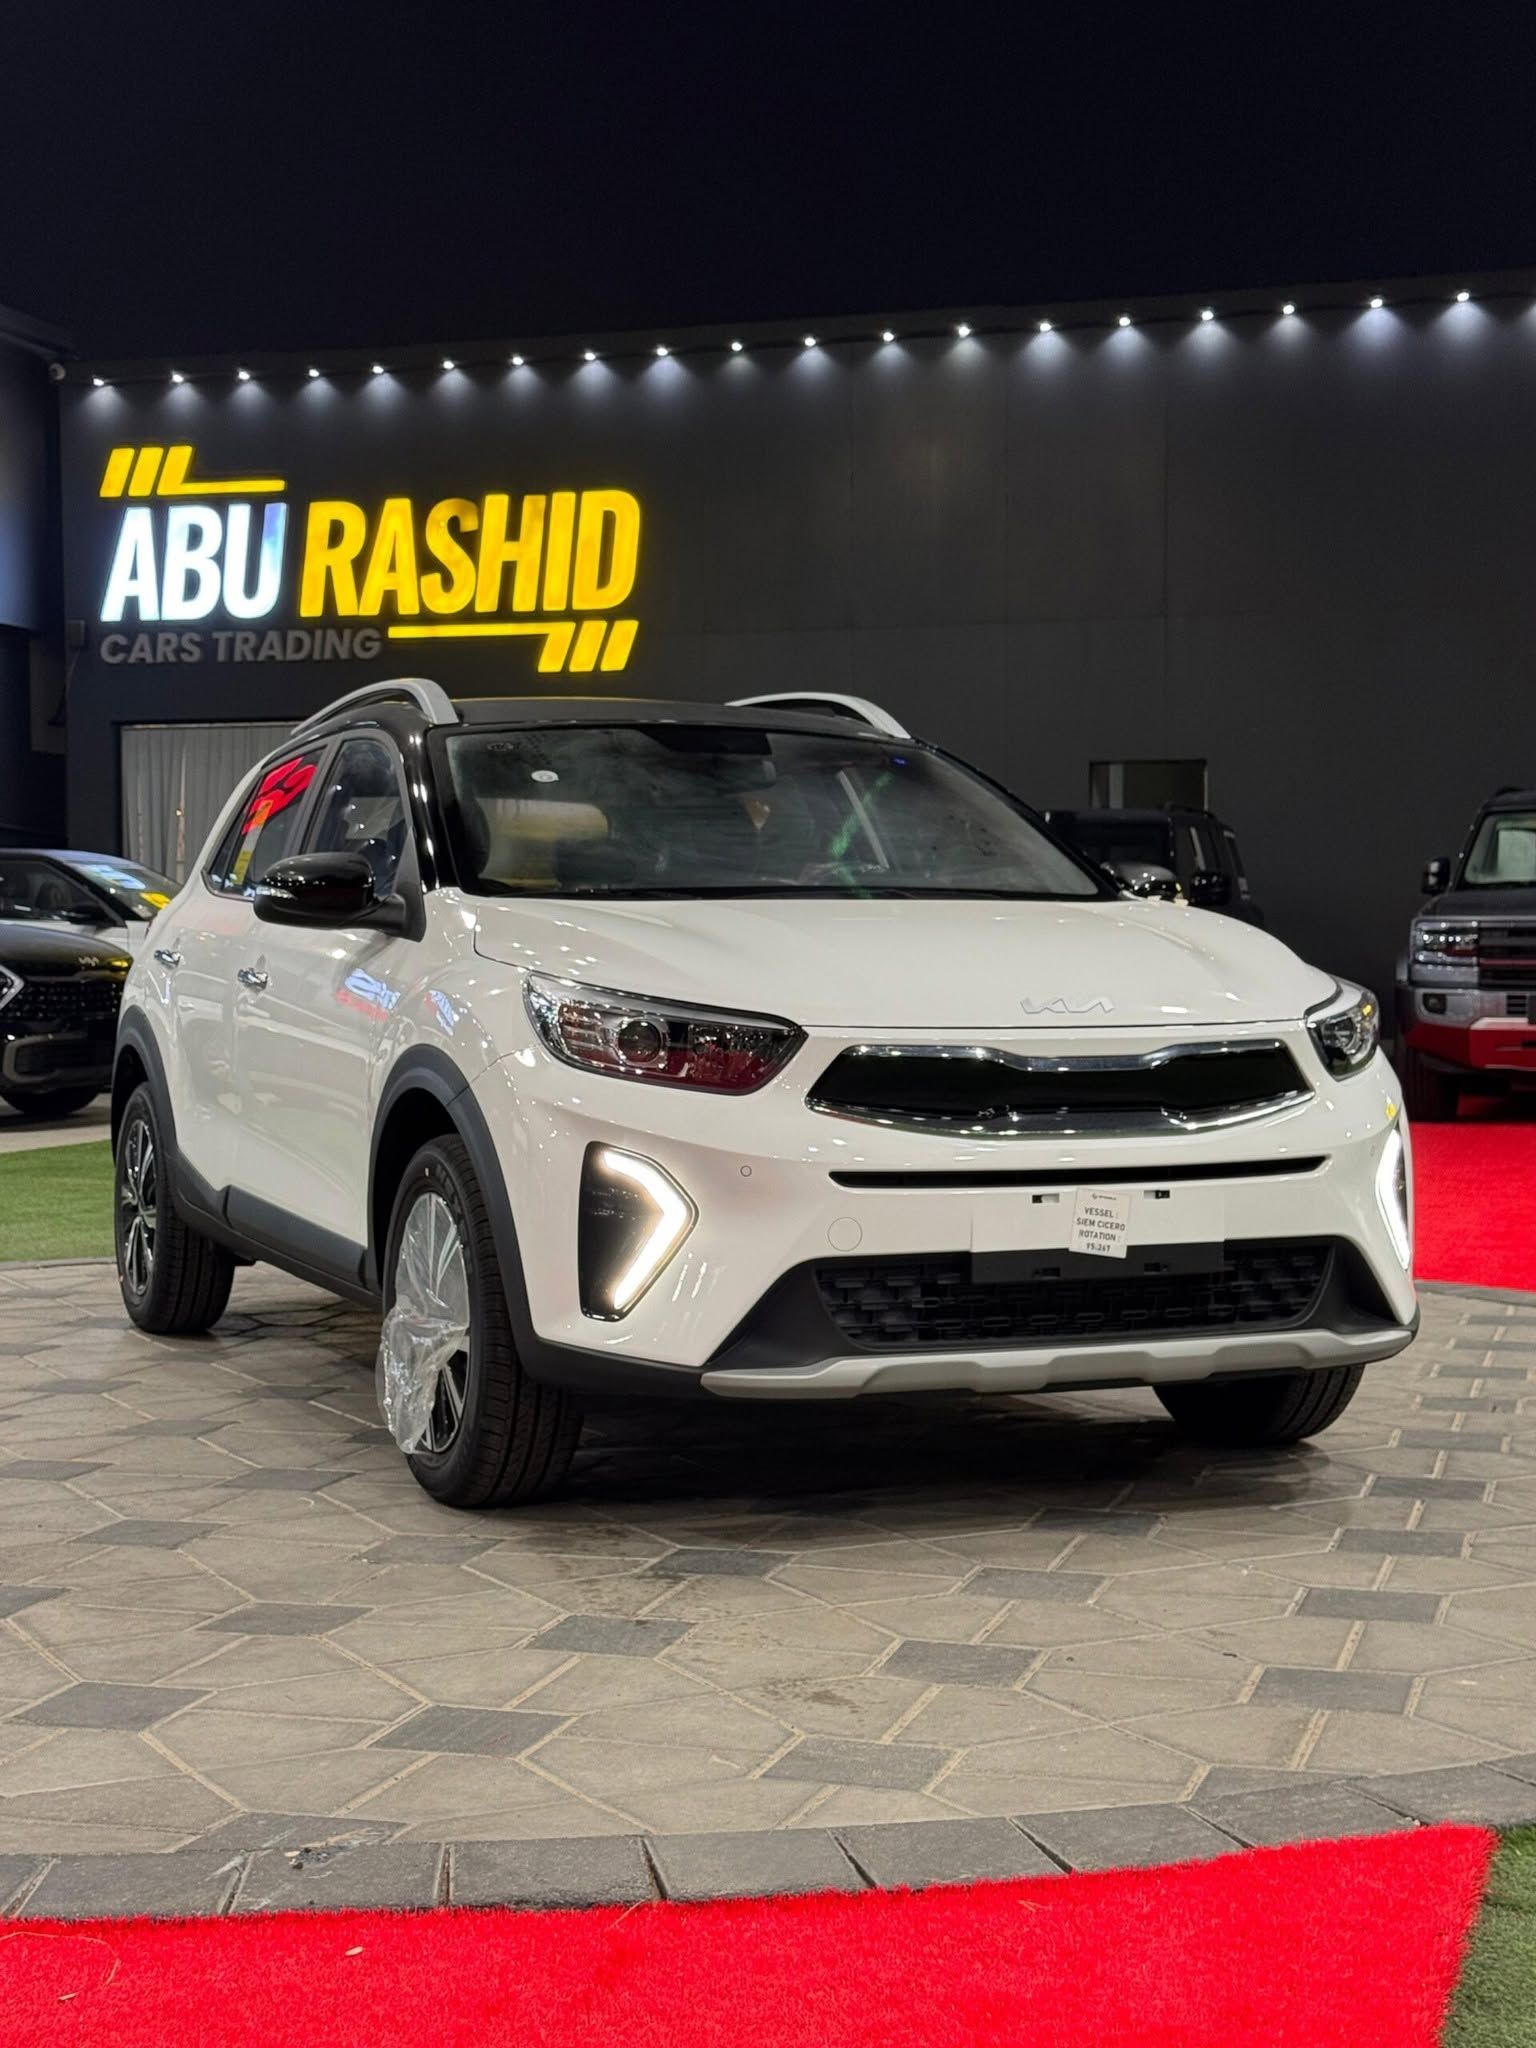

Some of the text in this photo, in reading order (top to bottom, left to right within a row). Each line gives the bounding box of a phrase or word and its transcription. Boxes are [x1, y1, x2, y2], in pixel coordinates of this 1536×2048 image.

[100, 490, 640, 621] ABU RASHID
[100, 627, 381, 664] CARS TRADING
[1084, 1207, 1114, 1218] VESSEL
[1076, 1217, 1126, 1231] SIEM CICERO
[1079, 1229, 1116, 1241] ROTATION
